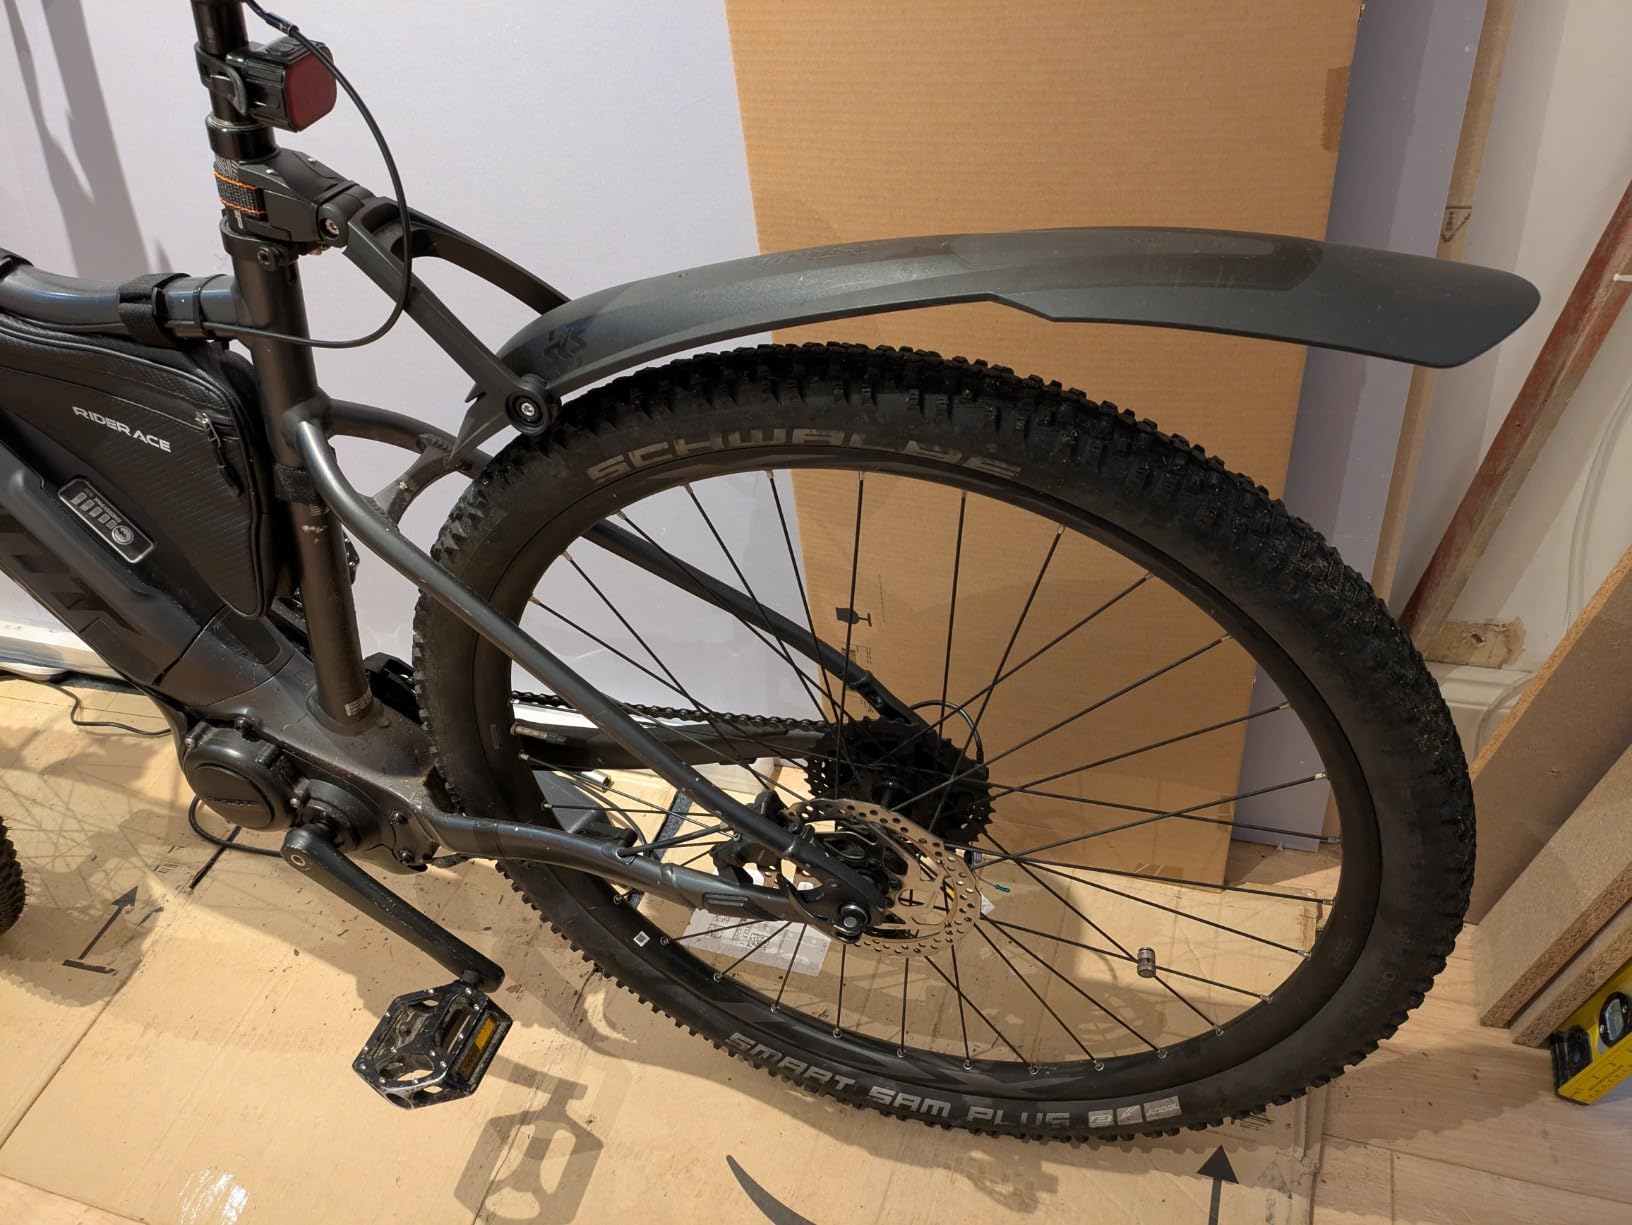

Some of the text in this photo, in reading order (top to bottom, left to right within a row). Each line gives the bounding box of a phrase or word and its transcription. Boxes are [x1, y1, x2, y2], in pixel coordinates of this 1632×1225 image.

[724, 1032, 1070, 1128] SMART SAM PLUS
